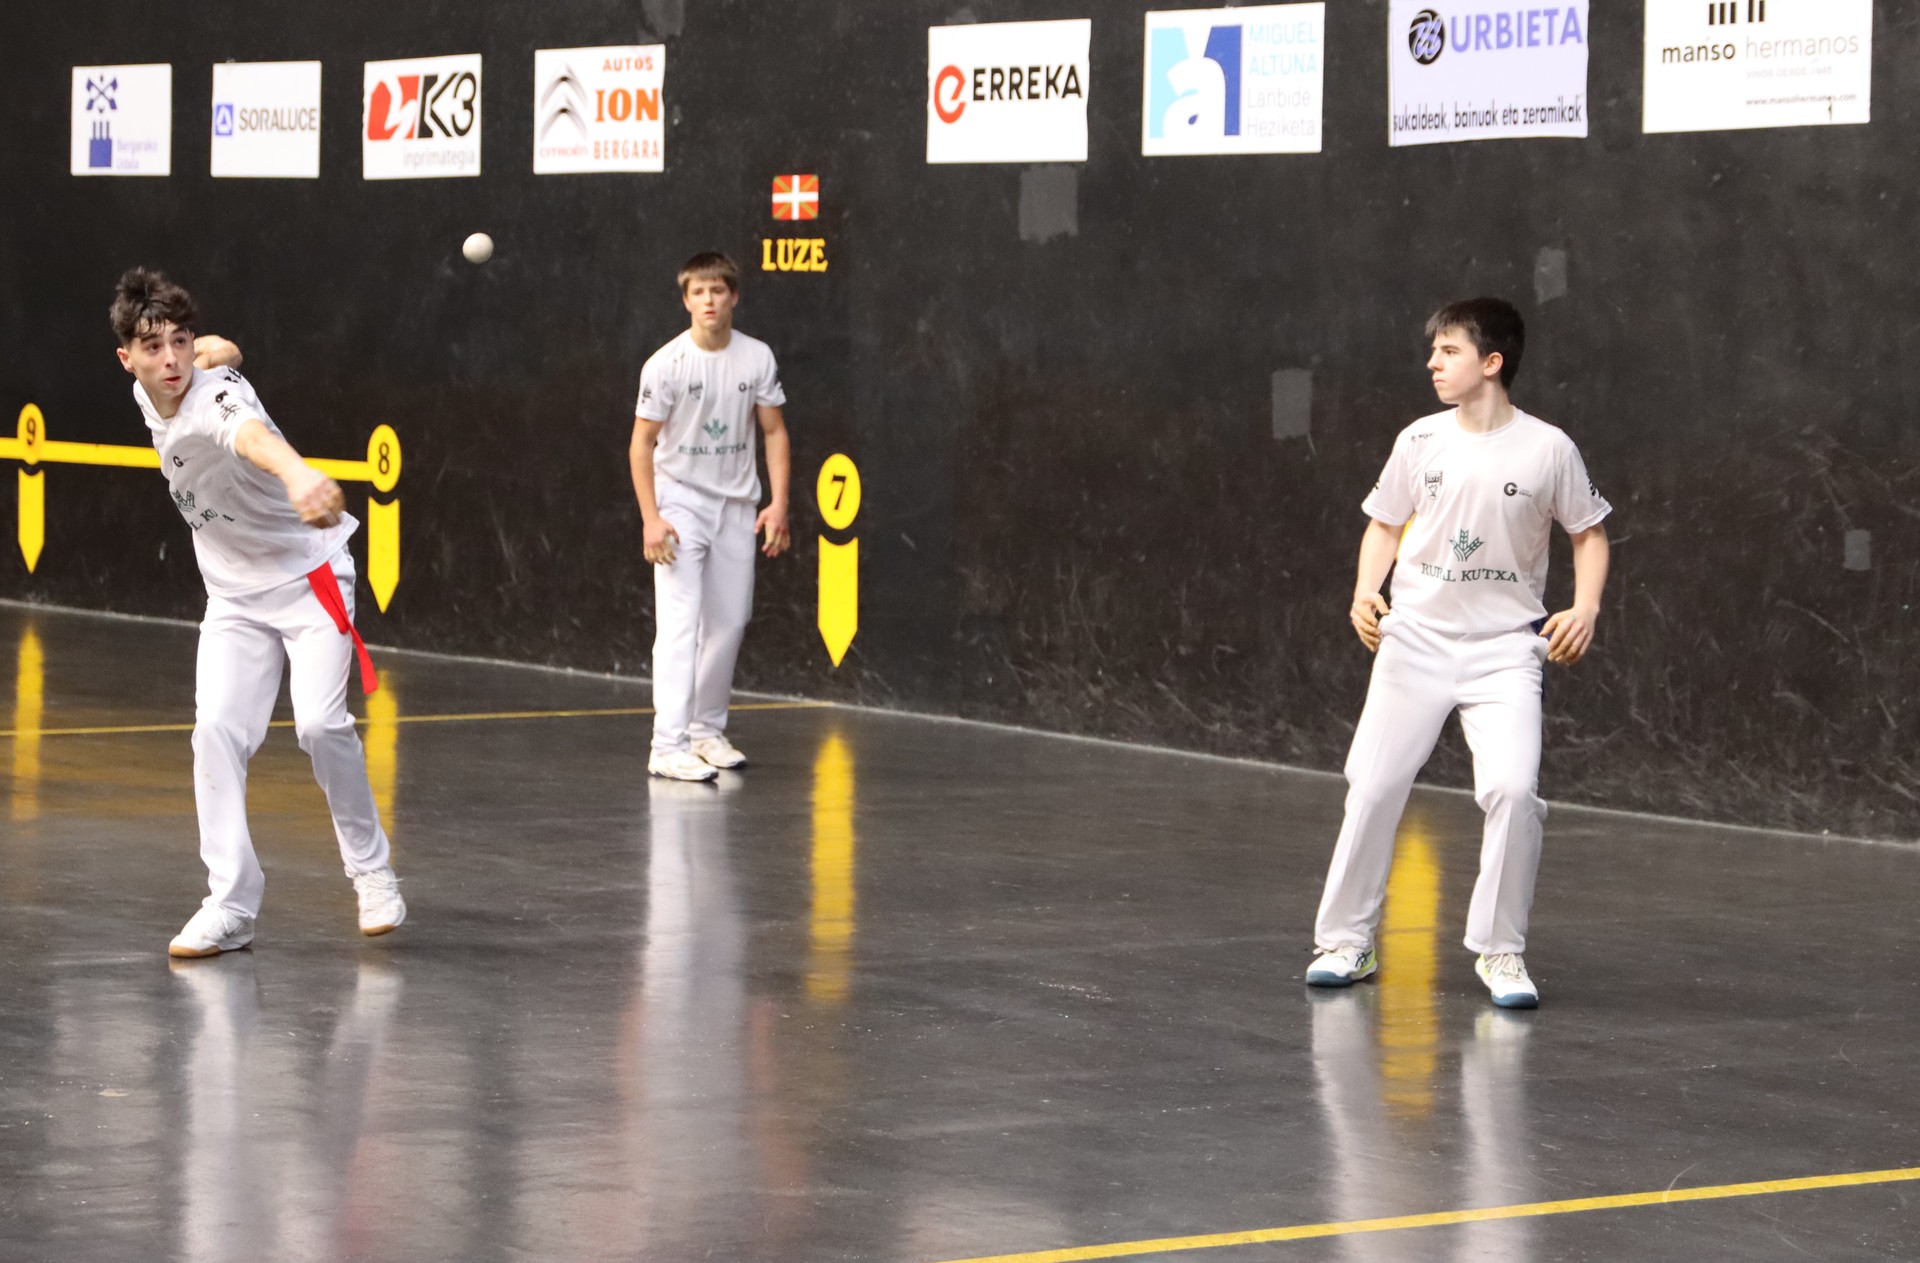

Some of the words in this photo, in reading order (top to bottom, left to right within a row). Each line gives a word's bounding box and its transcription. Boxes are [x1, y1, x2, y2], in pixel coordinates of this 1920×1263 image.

[1249, 22, 1317, 44] MIGUEL
[1450, 8, 1584, 53] URBIETA
[1662, 43, 1737, 63] manso
[1745, 35, 1860, 59] hermanos
[602, 56, 655, 73] AUTOS
[1248, 53, 1318, 75] ALTUNA
[973, 64, 1083, 101] ERREKA
[1247, 84, 1313, 109] Lanbide
[418, 70, 477, 138] K3
[595, 88, 659, 122] ION
[1454, 99, 1498, 128] bainuak
[1502, 104, 1520, 125] eta
[1522, 96, 1581, 124] zeramikak
[238, 107, 318, 132] SORALUCE
[1246, 112, 1317, 137] Heziketa
[404, 148, 476, 170] inprimategia
[593, 140, 661, 161] BERGARA
[762, 238, 829, 273] LUZE
[26, 418, 37, 446] 9
[378, 442, 391, 475] 8
[831, 475, 847, 511] 7
[1461, 569, 1519, 583] KUTXA
